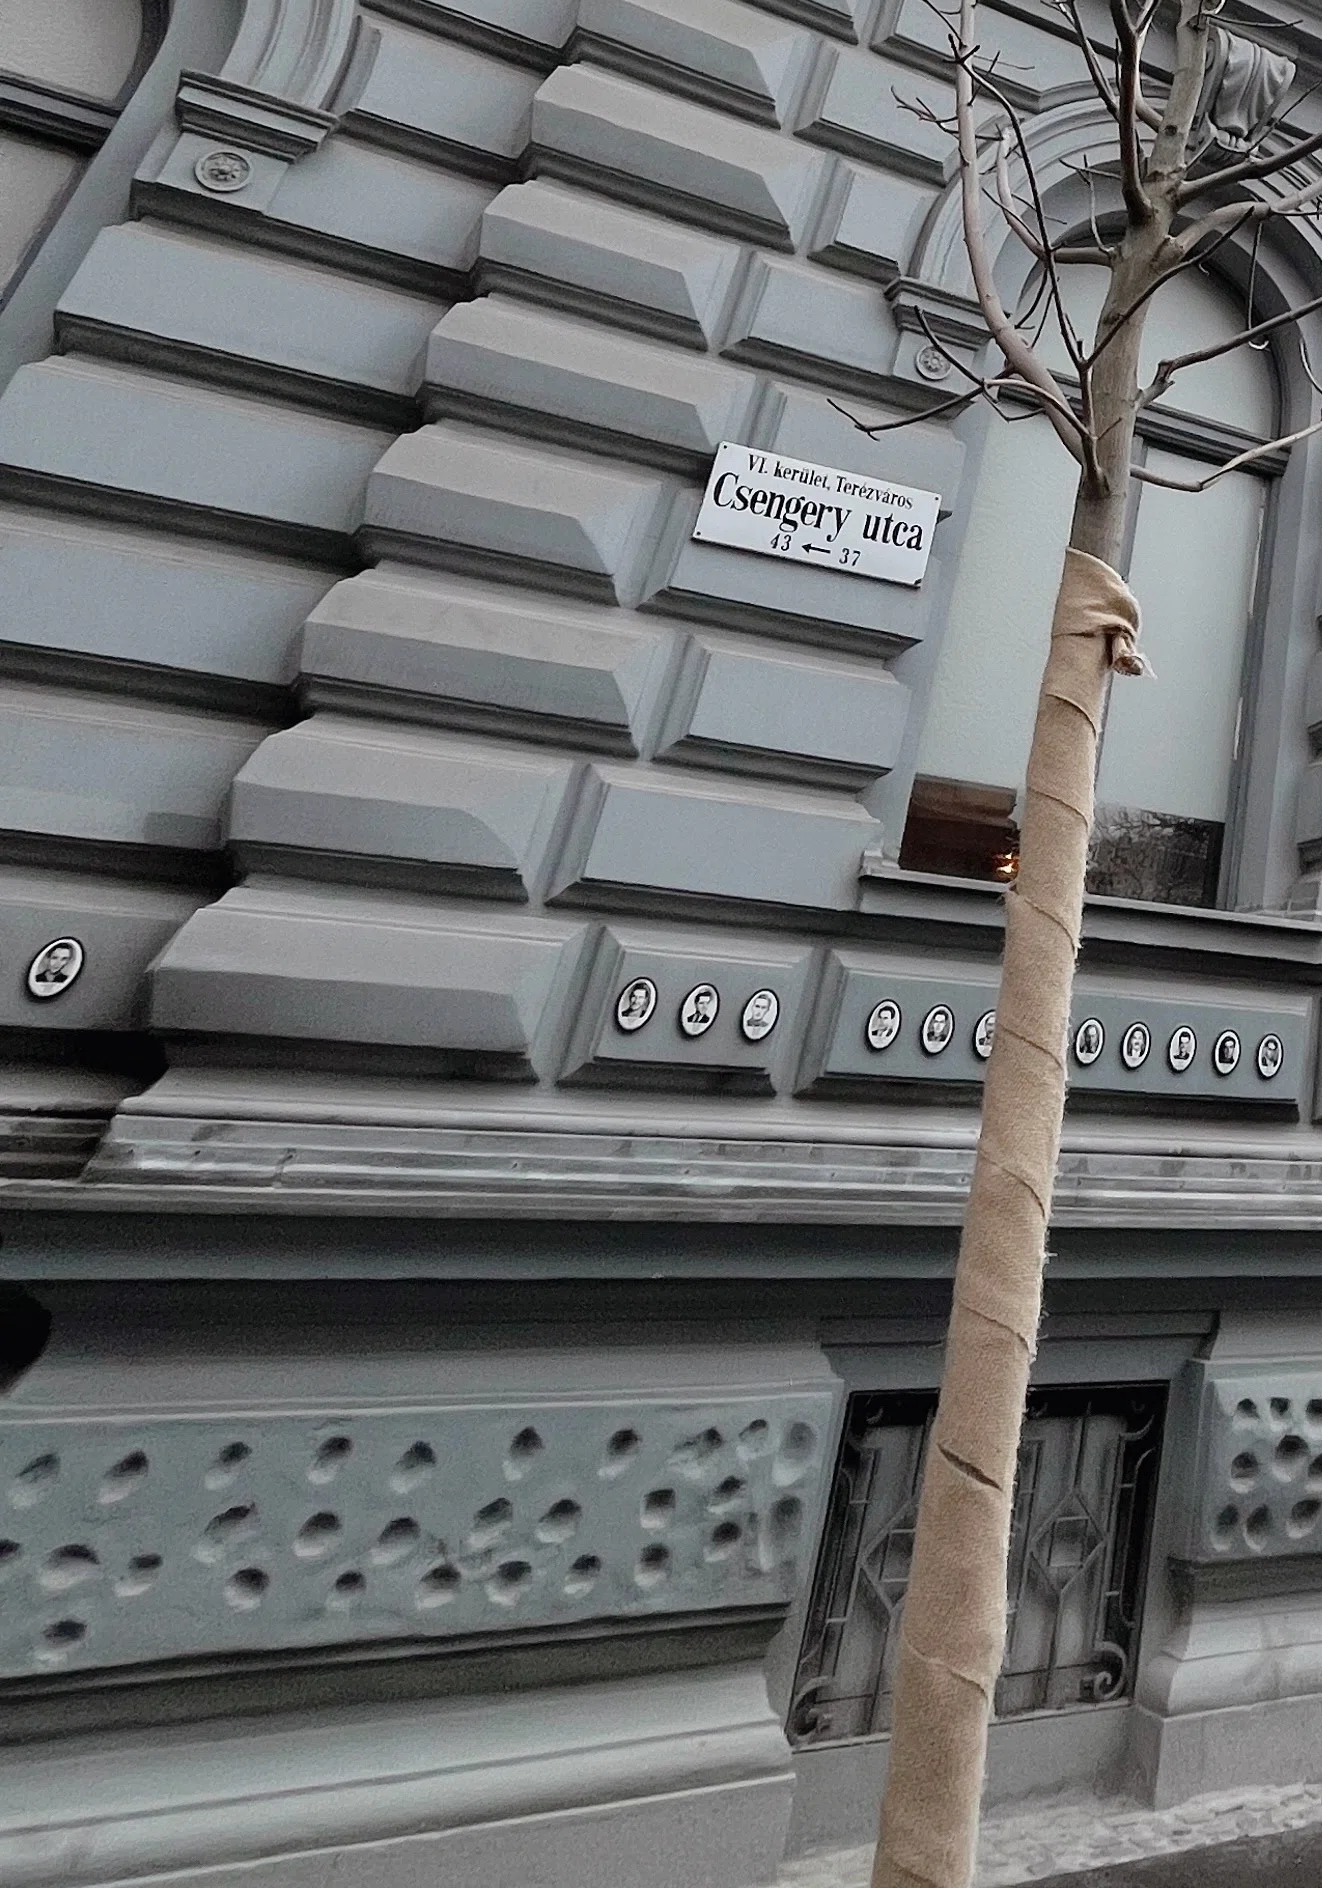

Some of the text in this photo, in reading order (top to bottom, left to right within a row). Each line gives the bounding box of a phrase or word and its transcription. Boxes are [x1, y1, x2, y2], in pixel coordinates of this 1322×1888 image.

[748, 454, 914, 510] VI. kerület, Terézváros
[713, 472, 923, 551] Csengery utca
[770, 533, 861, 567] 43 37
